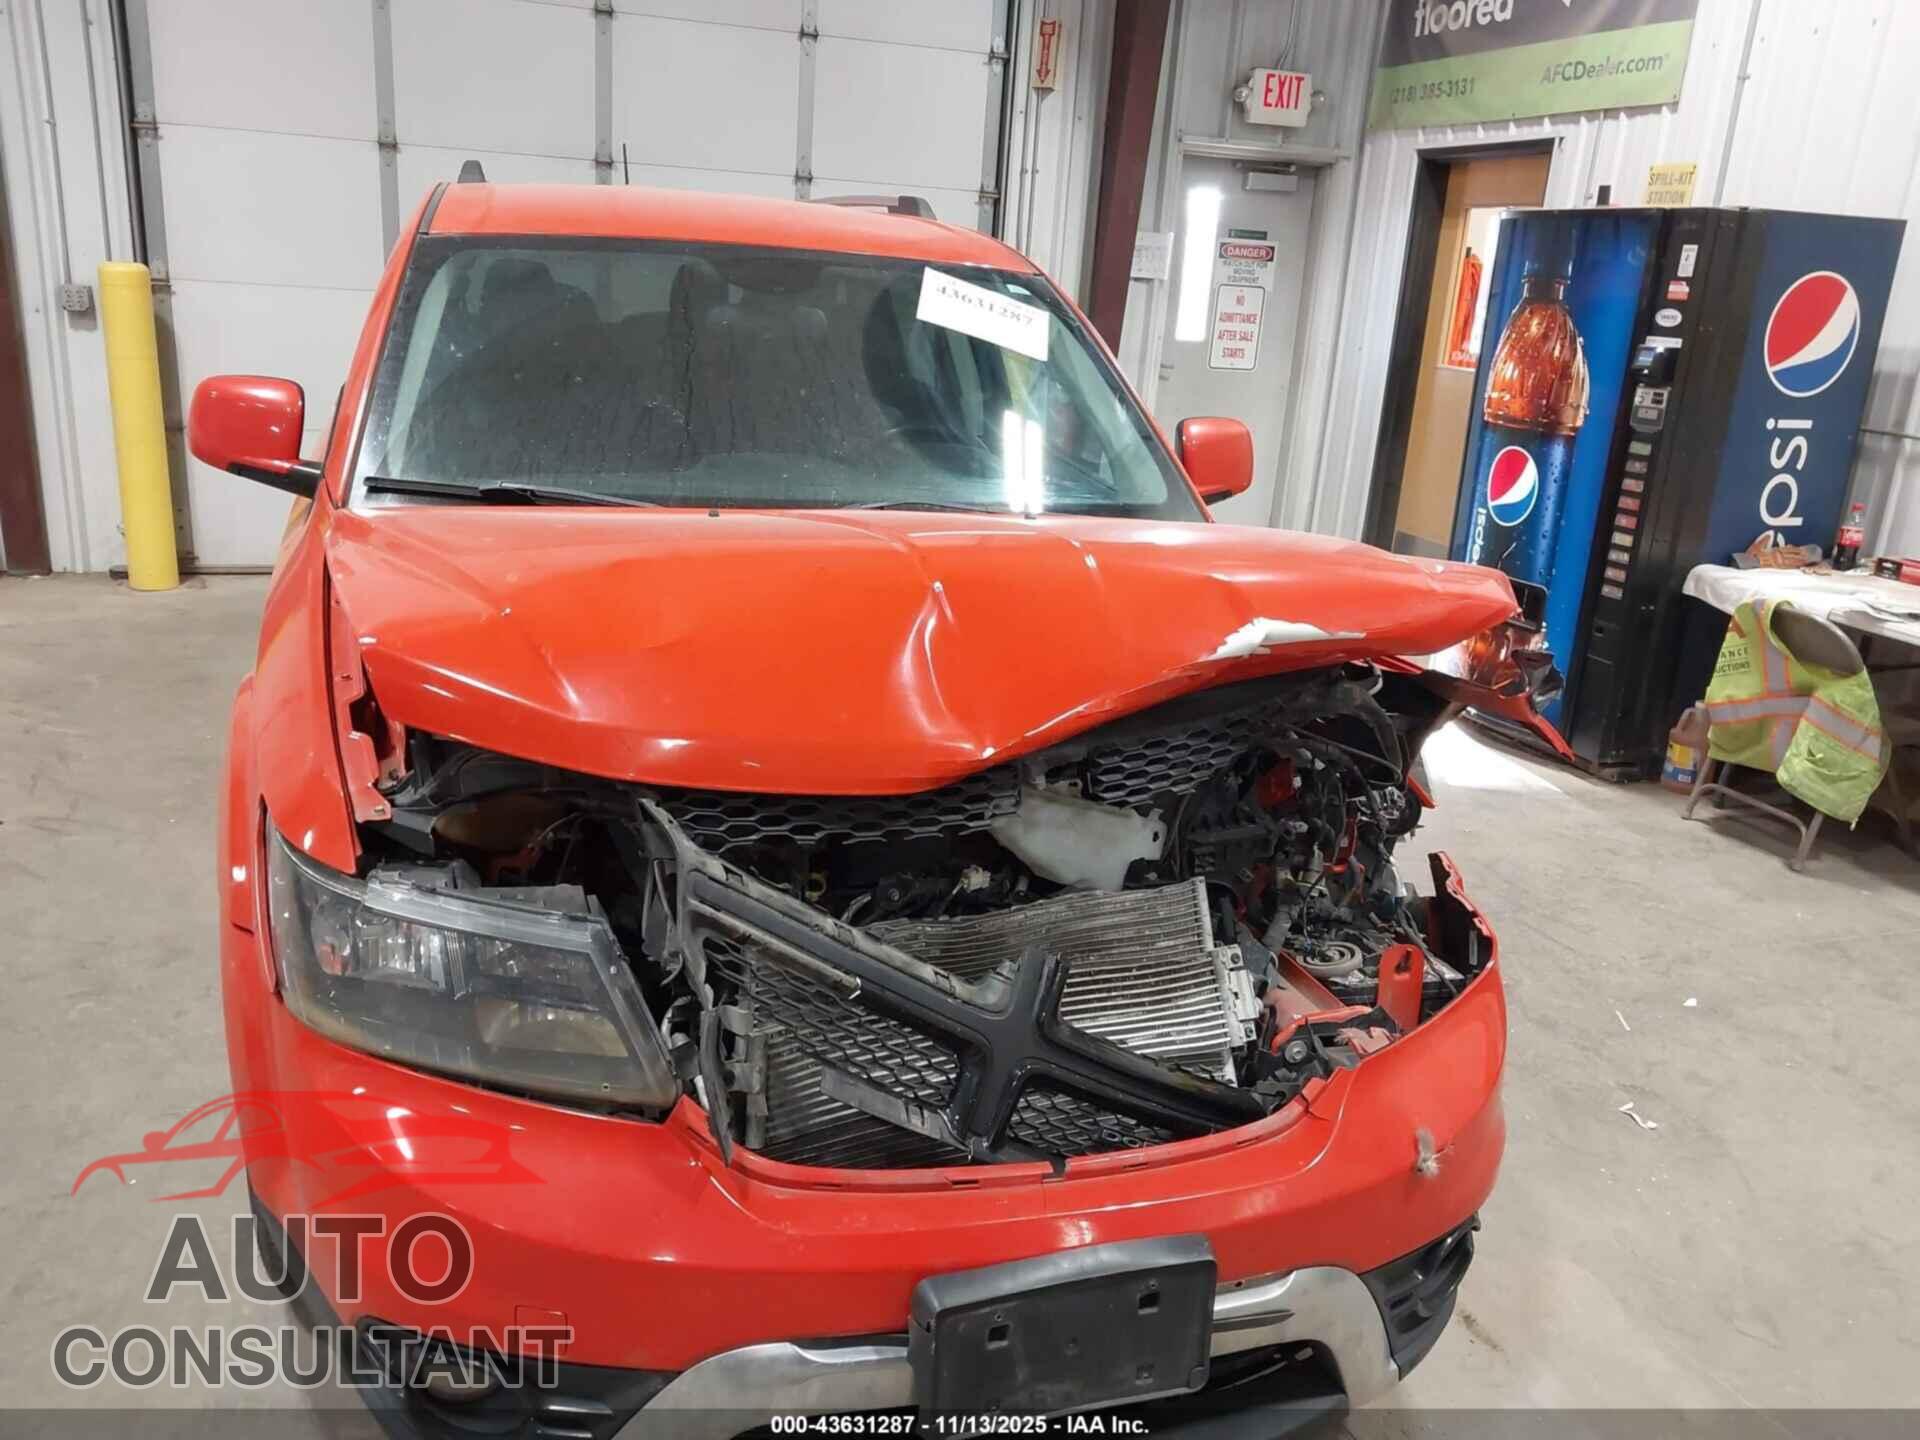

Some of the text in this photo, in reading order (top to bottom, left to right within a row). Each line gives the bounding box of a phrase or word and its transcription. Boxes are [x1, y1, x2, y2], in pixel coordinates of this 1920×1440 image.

[1263, 72, 1305, 110] EXIT
[1648, 171, 1694, 186] SPILL-KIT
[1646, 190, 1686, 205] STATION
[1227, 246, 1266, 258] DANGER
[1235, 295, 1246, 306] NO
[1219, 312, 1257, 325] ADMITTANCE
[1217, 329, 1254, 343] AFTER SALE
[1222, 346, 1245, 360] STARTS
[1471, 507, 1487, 565] epsi
